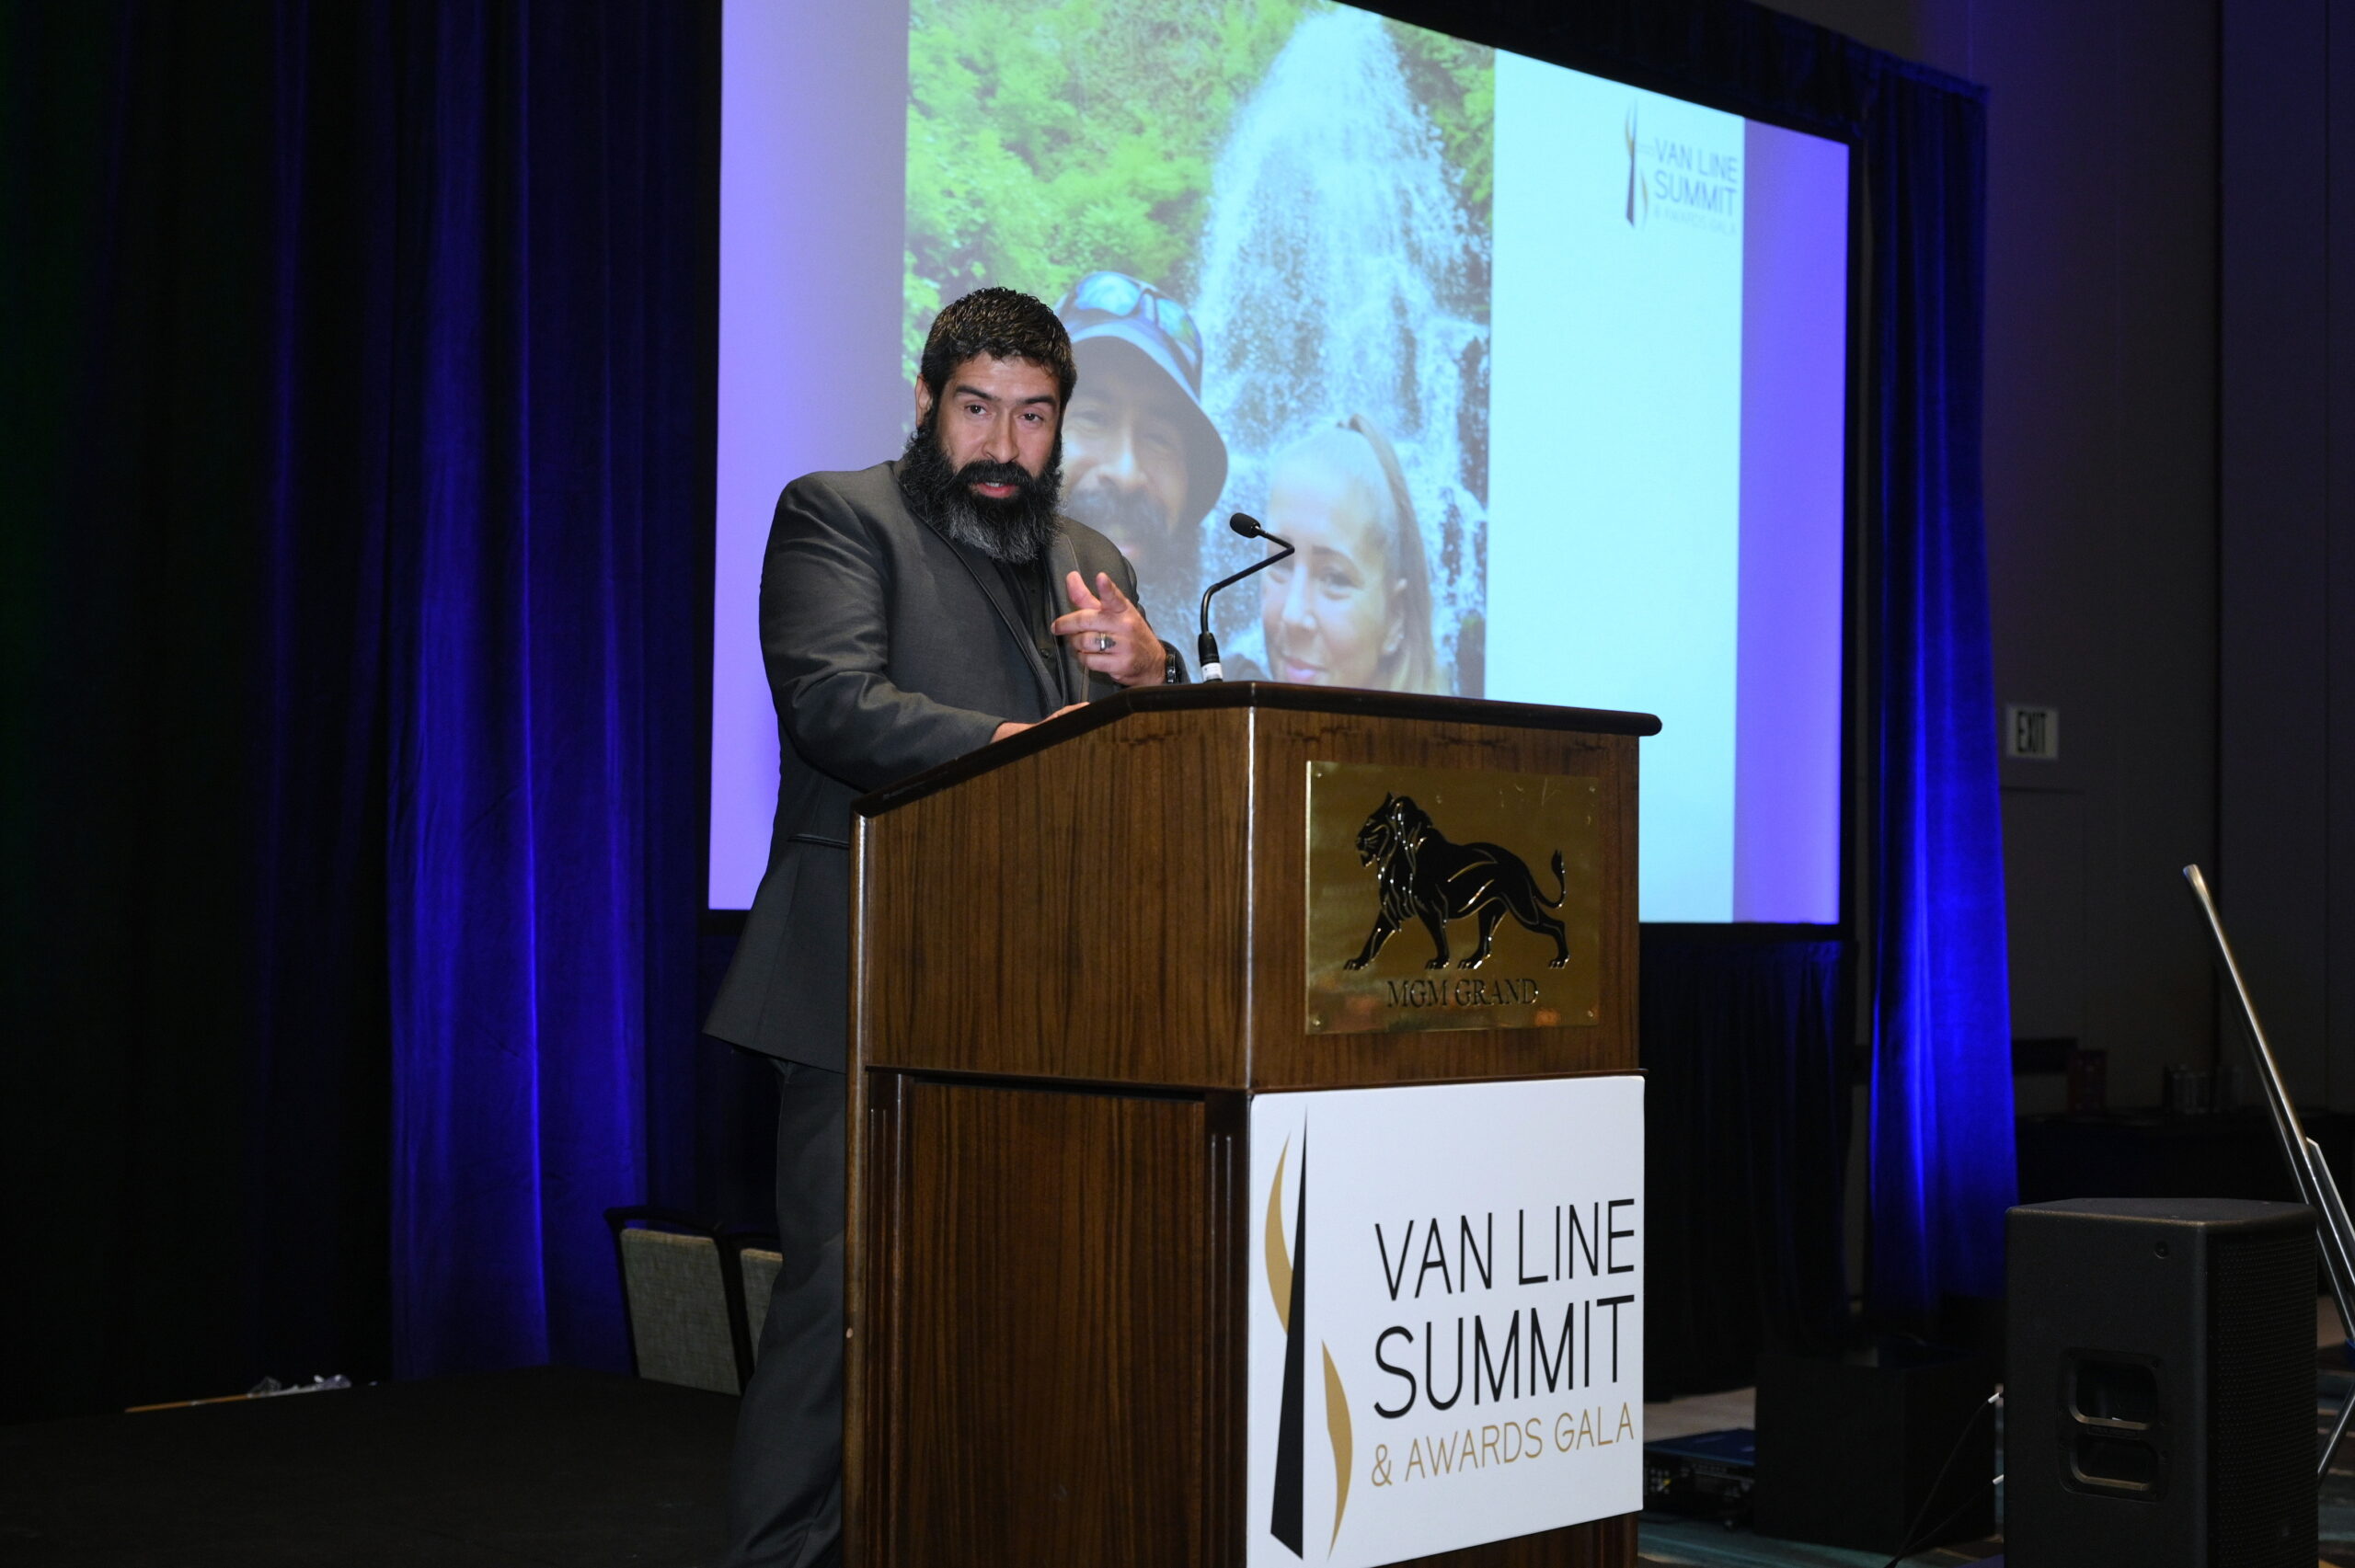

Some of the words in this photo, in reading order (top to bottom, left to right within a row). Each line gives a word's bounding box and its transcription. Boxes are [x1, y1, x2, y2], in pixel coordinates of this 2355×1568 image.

[1654, 137, 1693, 170] VAN
[1698, 148, 1737, 183] LINE
[1654, 169, 1737, 216] SUMMIT
[2016, 710, 2046, 754] EXIT
[1387, 979, 1447, 1008] MGM
[1454, 979, 1539, 1007] GRAND
[1374, 1212, 1492, 1300] VAN
[1519, 1198, 1635, 1285] LINE
[1373, 1294, 1635, 1419] SUMMIT
[1371, 1444, 1392, 1486] &
[1405, 1417, 1544, 1482] AWARDS
[1555, 1402, 1634, 1452] GALA
